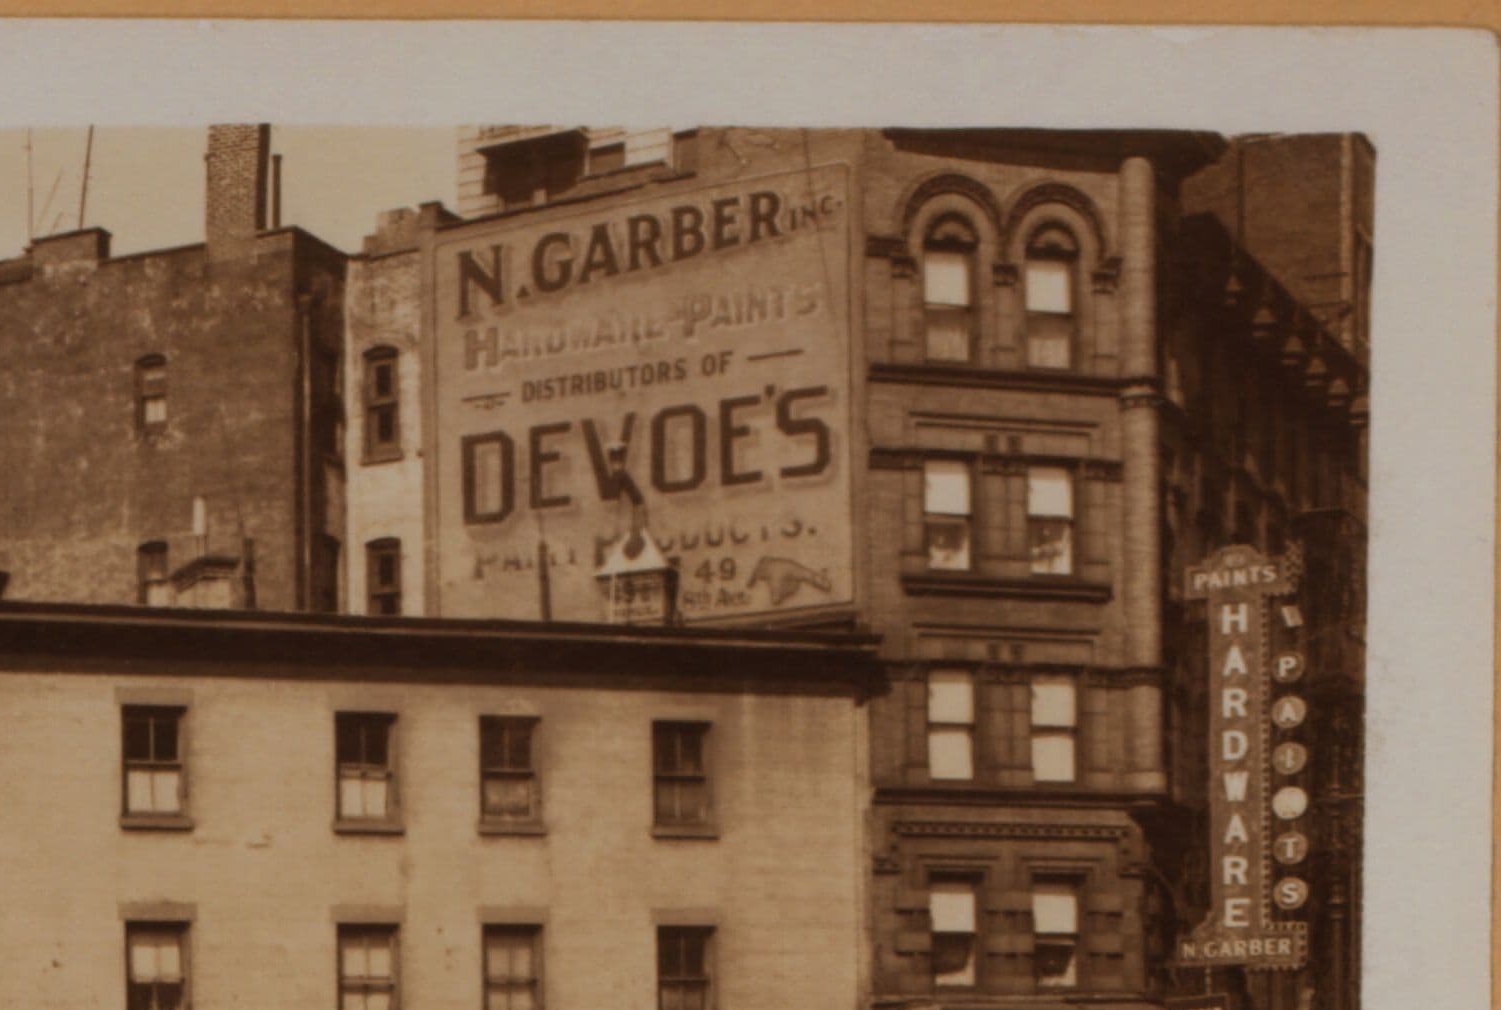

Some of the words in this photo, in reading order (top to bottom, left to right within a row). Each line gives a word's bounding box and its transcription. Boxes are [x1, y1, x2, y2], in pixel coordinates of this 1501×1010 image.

[521, 357, 688, 404] DISTRIBUTORS
[701, 350, 734, 377] OF
[460, 384, 832, 526] DEVOE'S
[695, 556, 736, 584] 49
[1192, 565, 1277, 592] PAINTS
[1220, 602, 1251, 928] HARDWARE
[1275, 653, 1302, 905] PAITS
